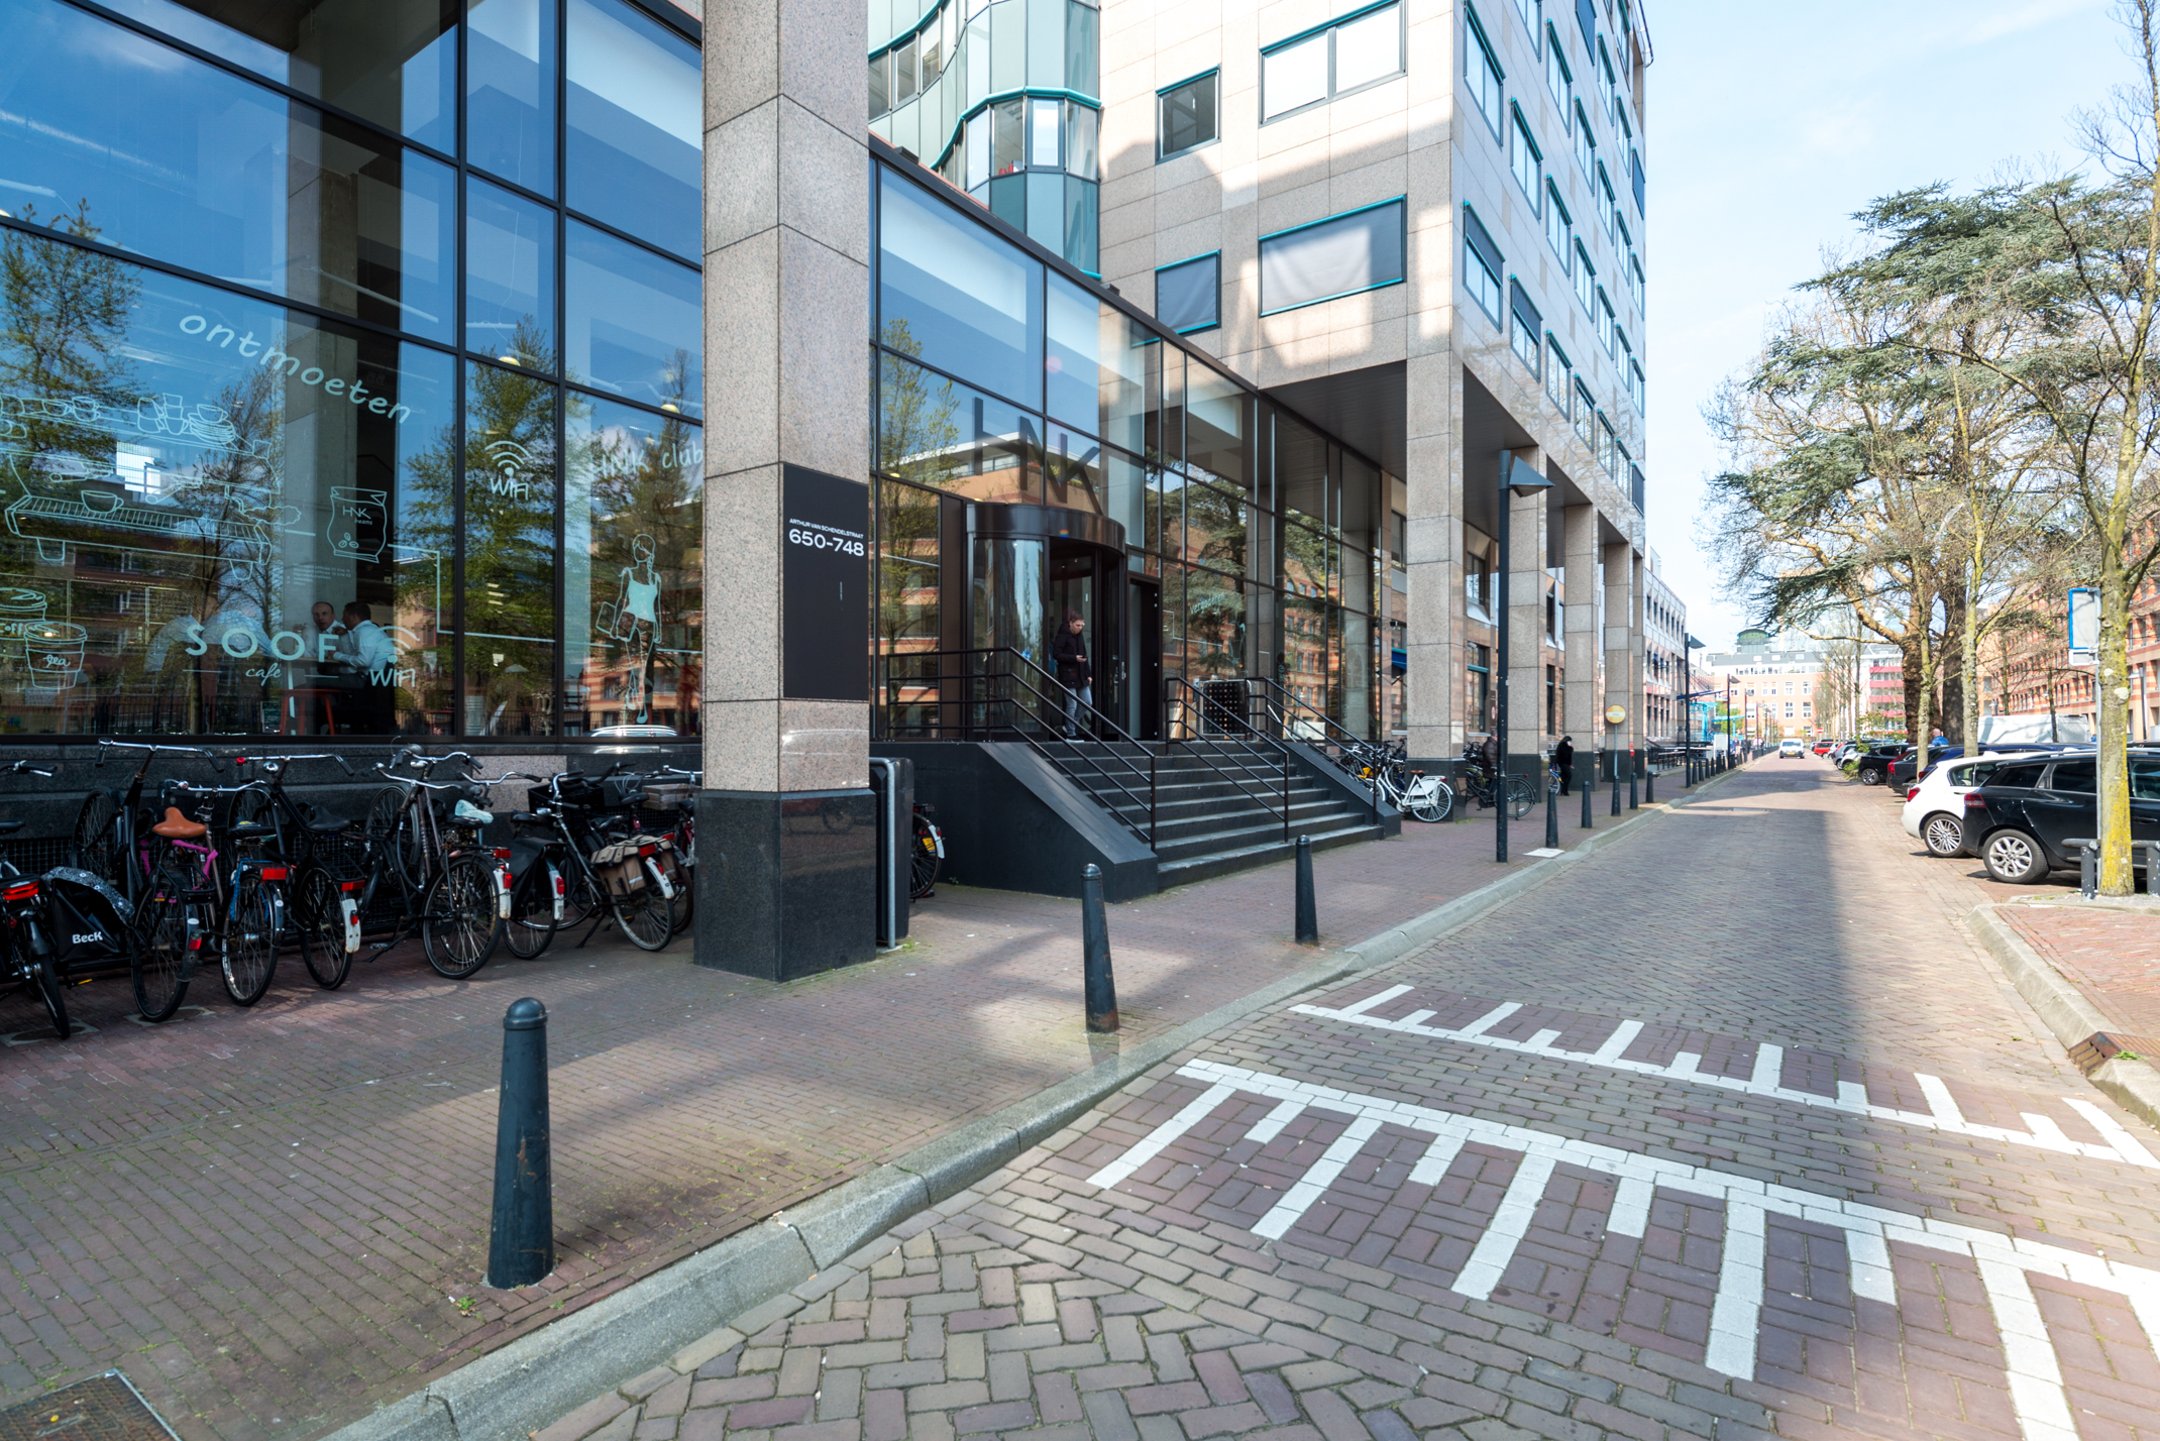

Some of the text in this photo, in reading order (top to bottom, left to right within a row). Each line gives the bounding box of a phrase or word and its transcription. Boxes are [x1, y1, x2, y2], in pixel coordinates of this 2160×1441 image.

[179, 315, 412, 424] ontmoeten
[662, 441, 703, 469] club
[973, 396, 1104, 516] HNK
[342, 505, 372, 519] HNK
[788, 528, 865, 556] 650-748
[184, 624, 340, 663] SOOF
